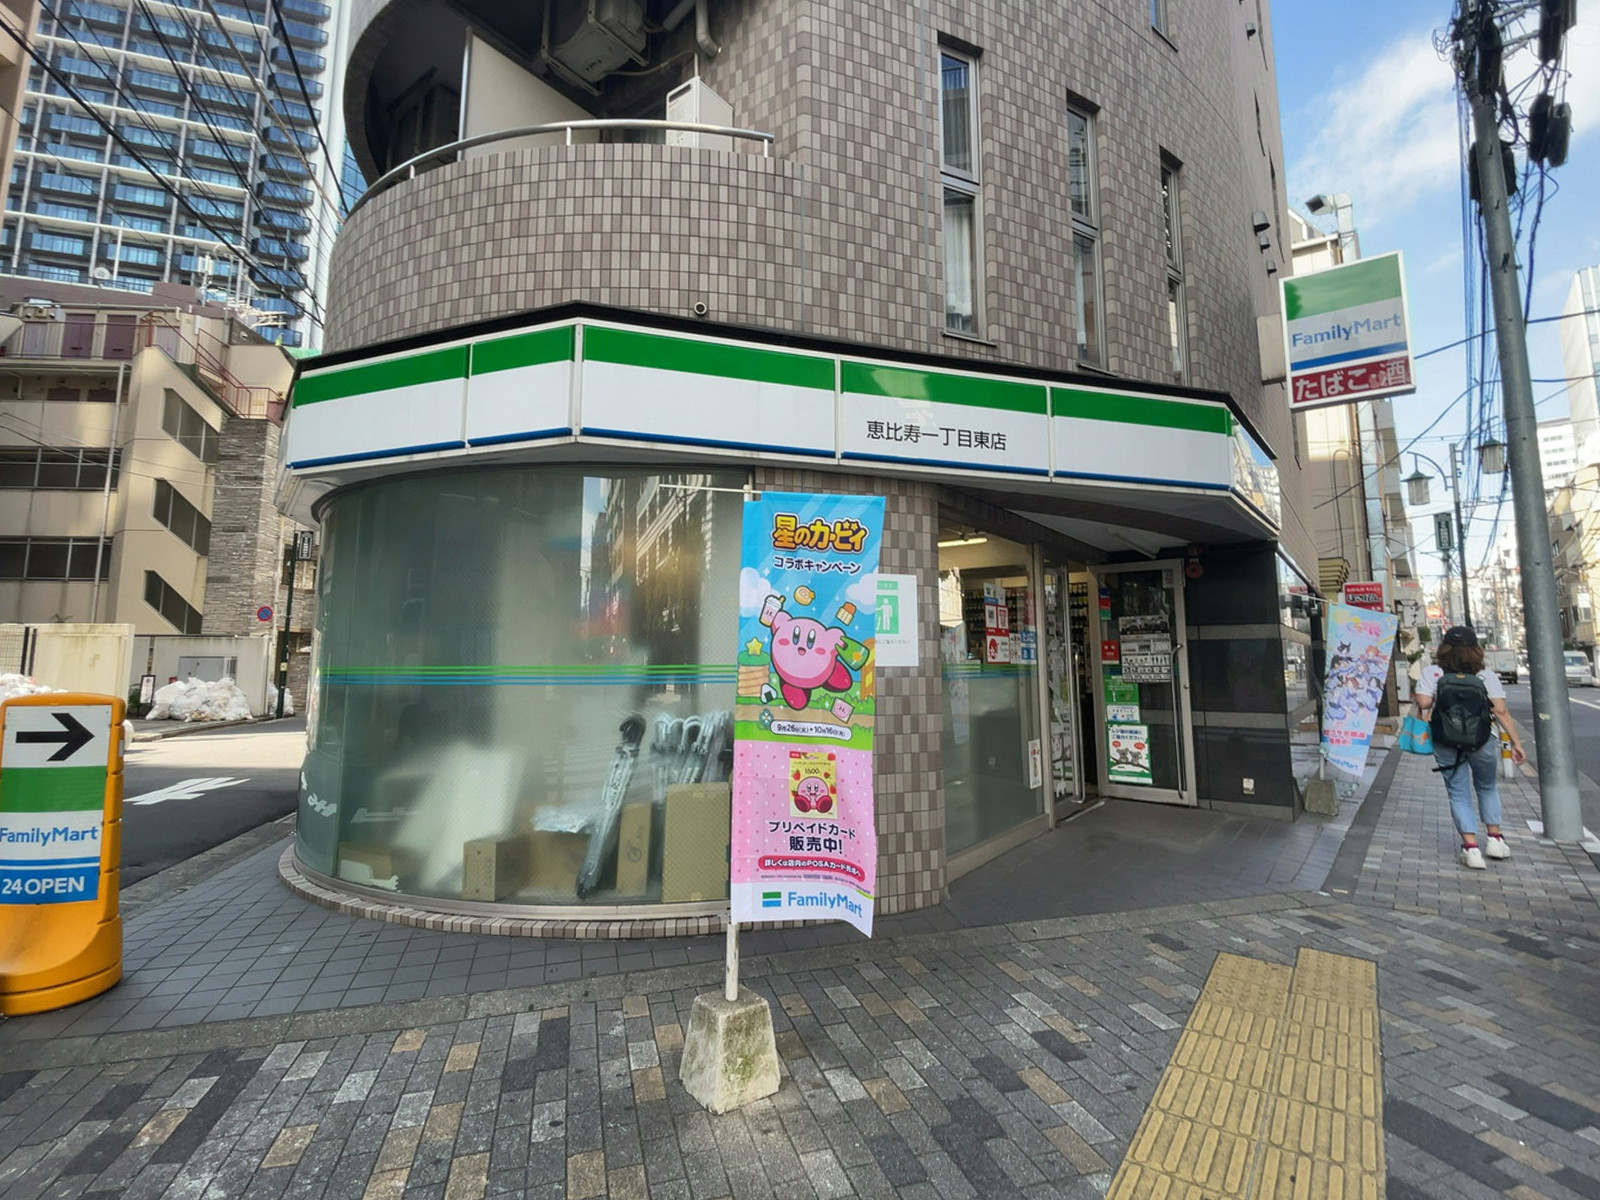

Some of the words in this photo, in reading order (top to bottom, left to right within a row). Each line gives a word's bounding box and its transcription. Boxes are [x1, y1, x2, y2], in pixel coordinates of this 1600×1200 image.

[1292, 313, 1402, 347] FamilyMart
[1295, 367, 1369, 401] たばこ
[867, 420, 1007, 451] 恵比寿一丁目東店
[774, 556, 861, 574] コラボキャンペーン
[0, 826, 99, 847] FamilyMart
[769, 821, 856, 839] プリペイドカード
[789, 836, 843, 854] 販売中!
[788, 890, 863, 918] FamilyMart
